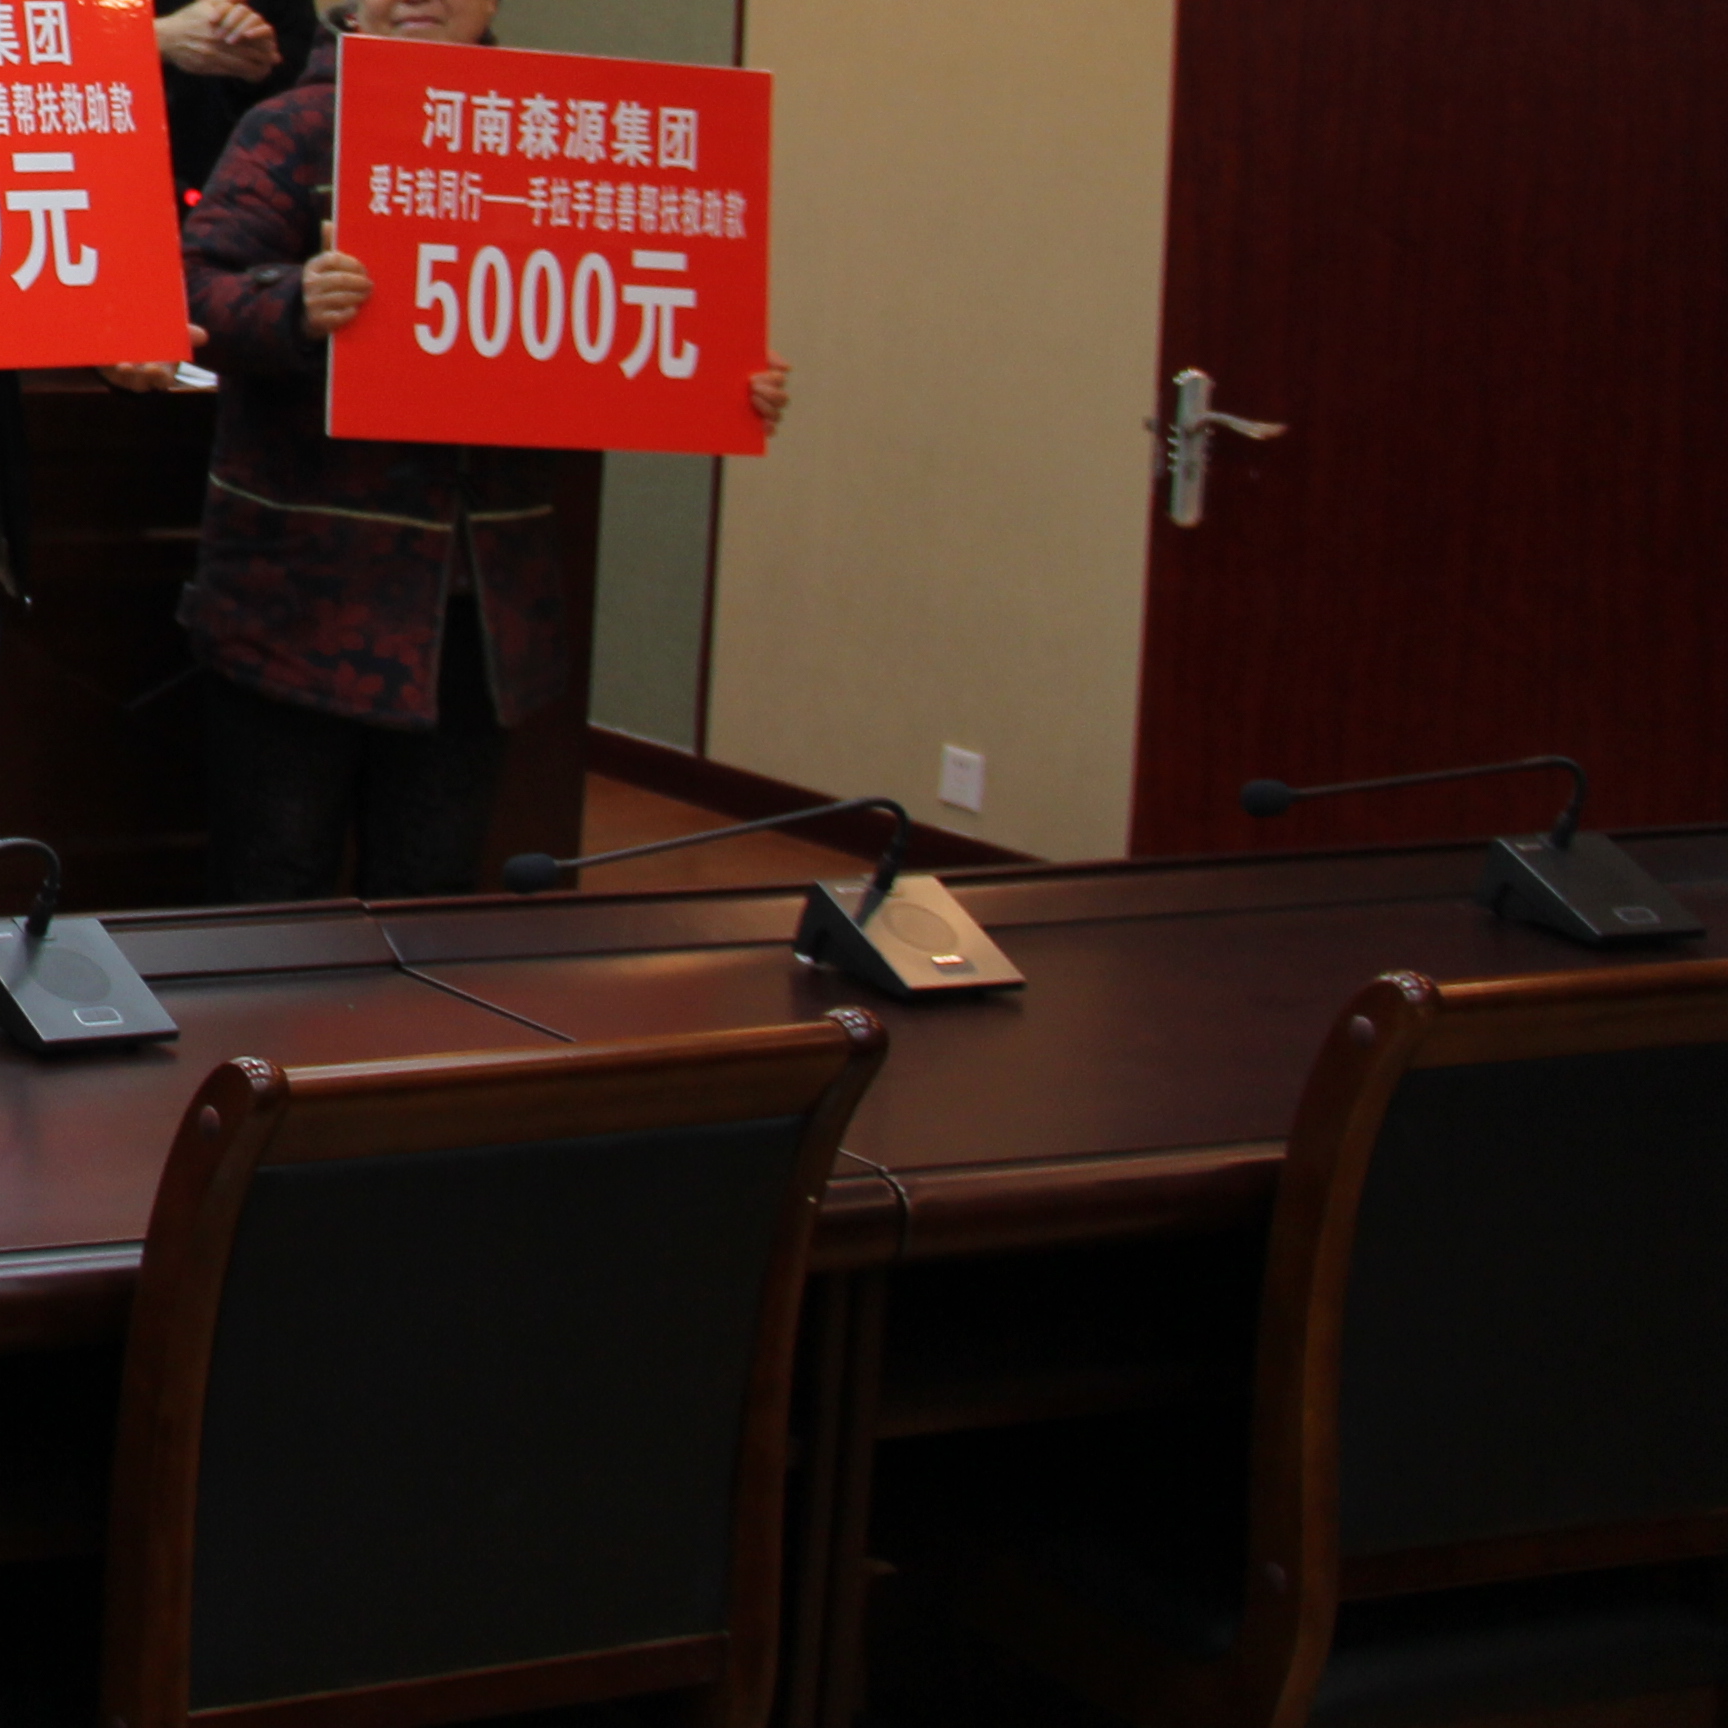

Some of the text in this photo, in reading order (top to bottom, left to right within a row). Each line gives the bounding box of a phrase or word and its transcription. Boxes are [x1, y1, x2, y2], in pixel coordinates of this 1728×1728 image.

[422, 87, 699, 171] 河南森源集团
[413, 243, 699, 380] 5000元
